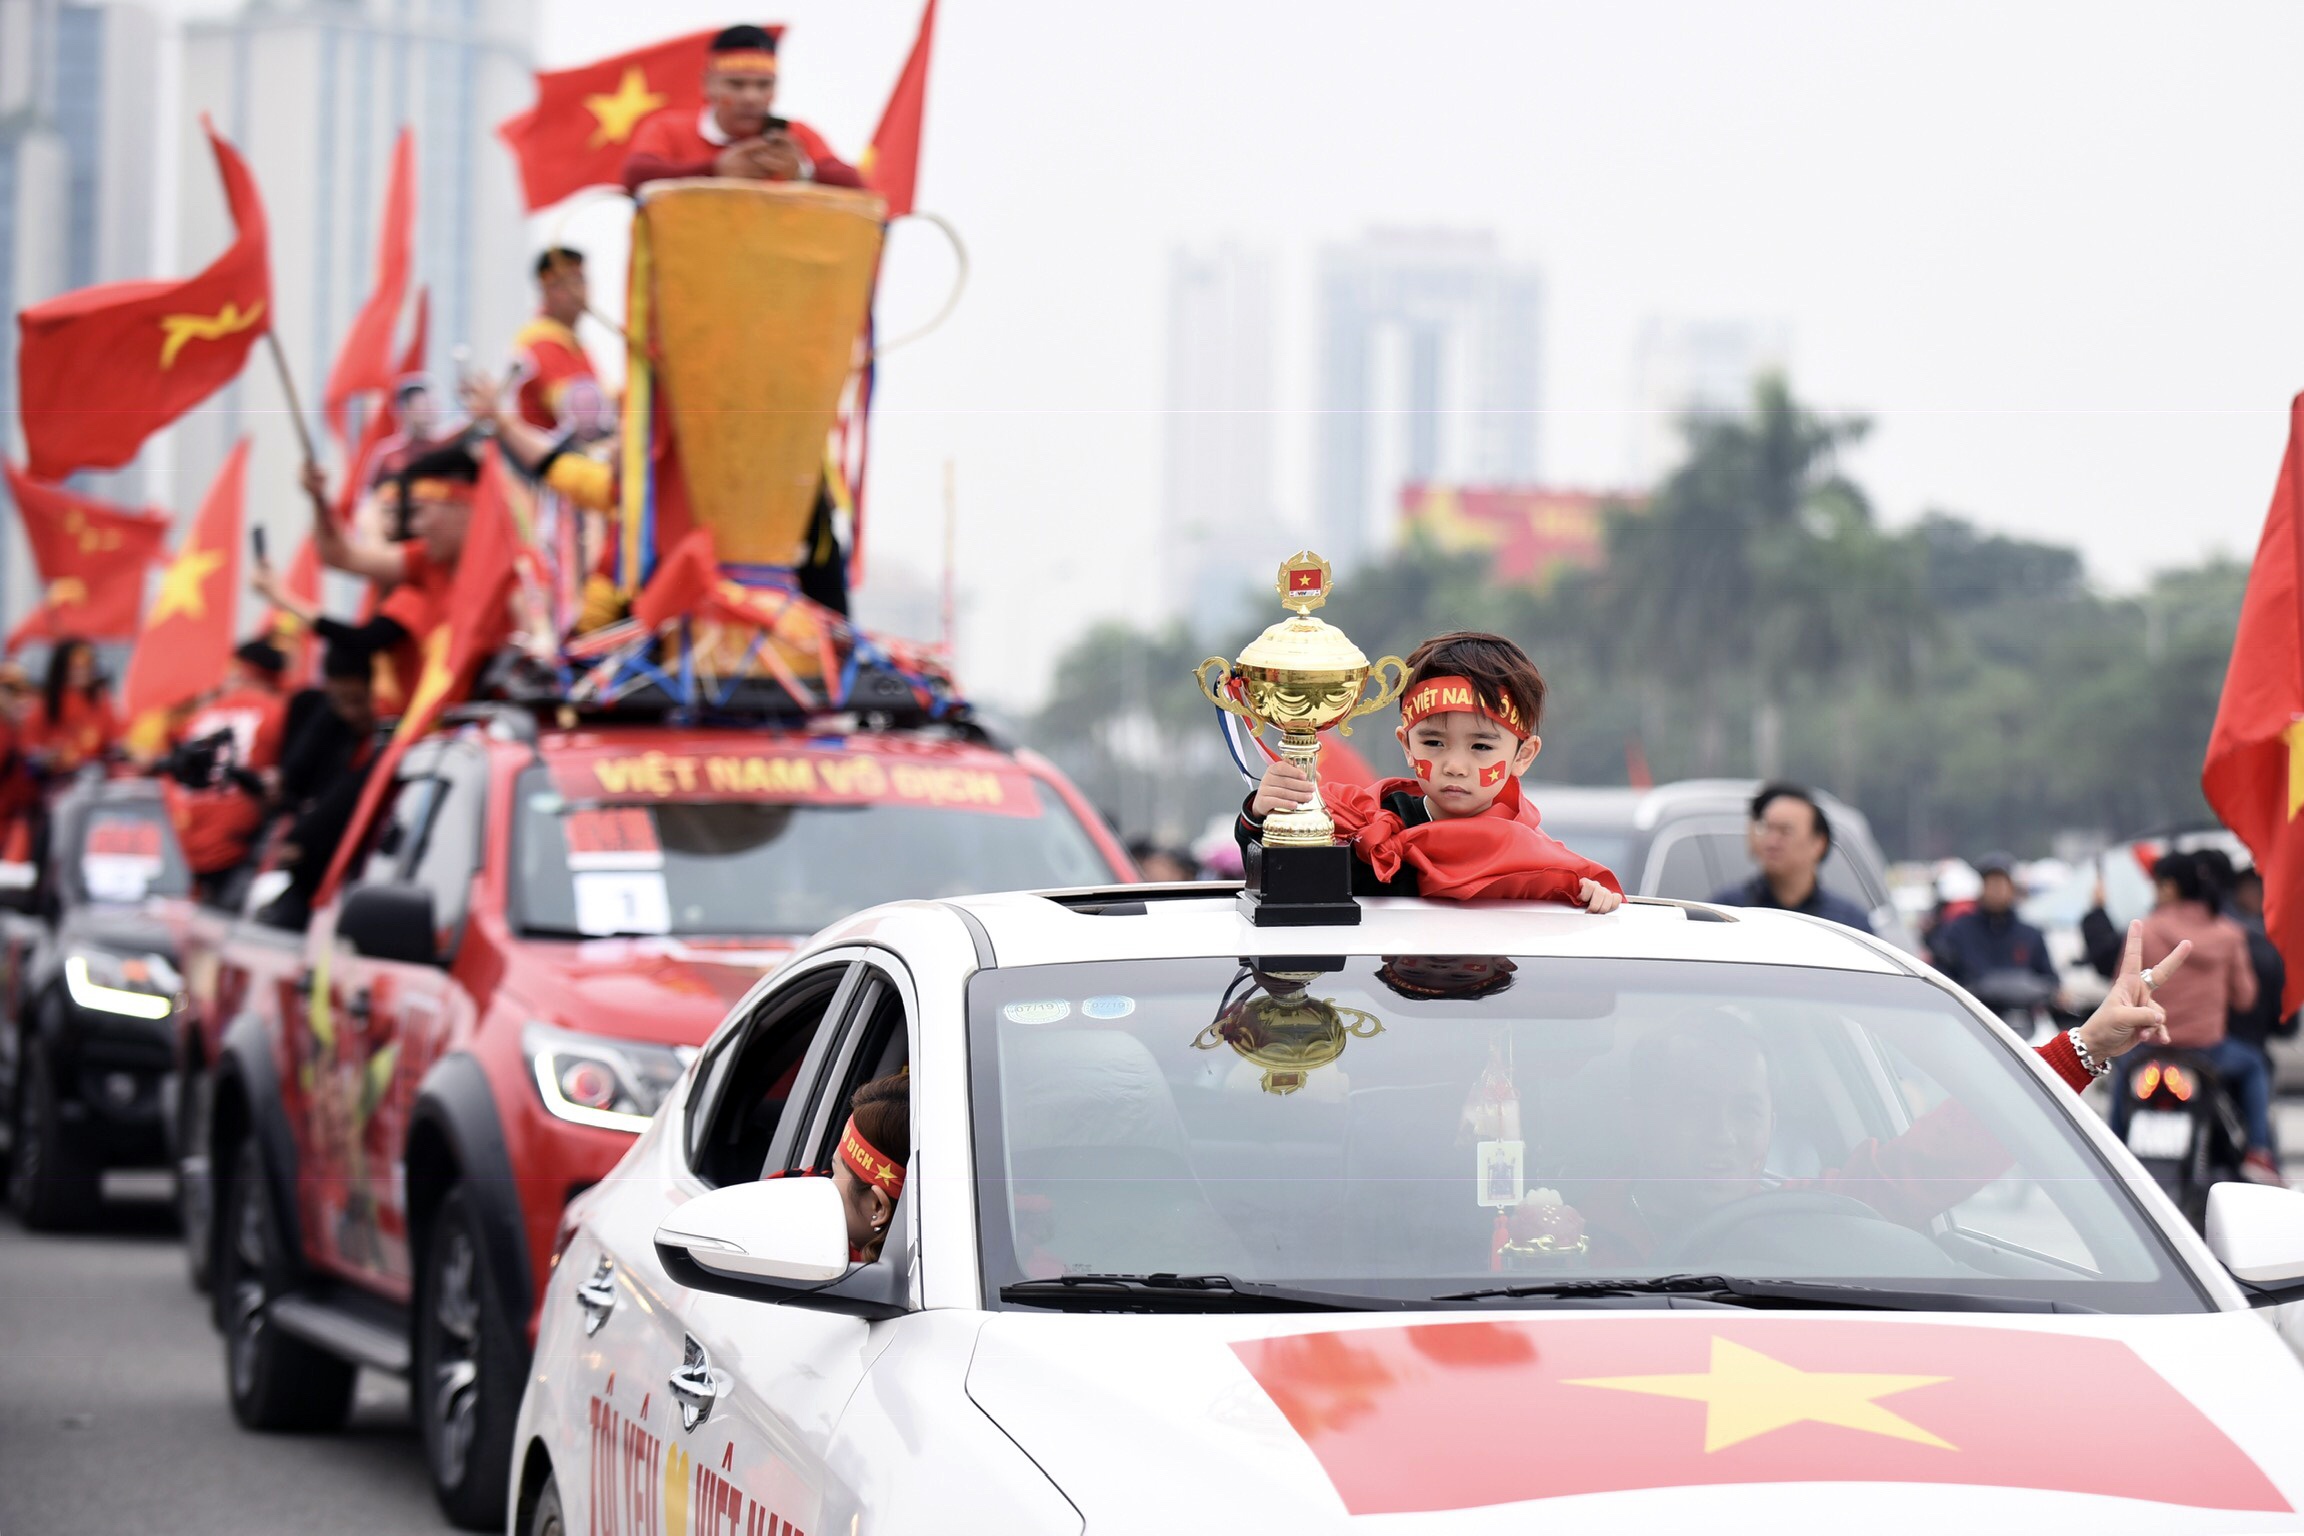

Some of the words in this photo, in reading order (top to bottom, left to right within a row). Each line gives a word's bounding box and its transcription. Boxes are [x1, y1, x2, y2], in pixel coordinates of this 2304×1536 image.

[1412, 687, 1439, 714] VIỆT
[595, 752, 697, 796] VIỆT
[705, 756, 818, 793] NAM
[819, 754, 887, 796] VÔ
[1015, 1003, 1055, 1013] 07/19
[846, 1136, 875, 1171] ĐỊCH
[590, 1370, 619, 1536] TÔI
